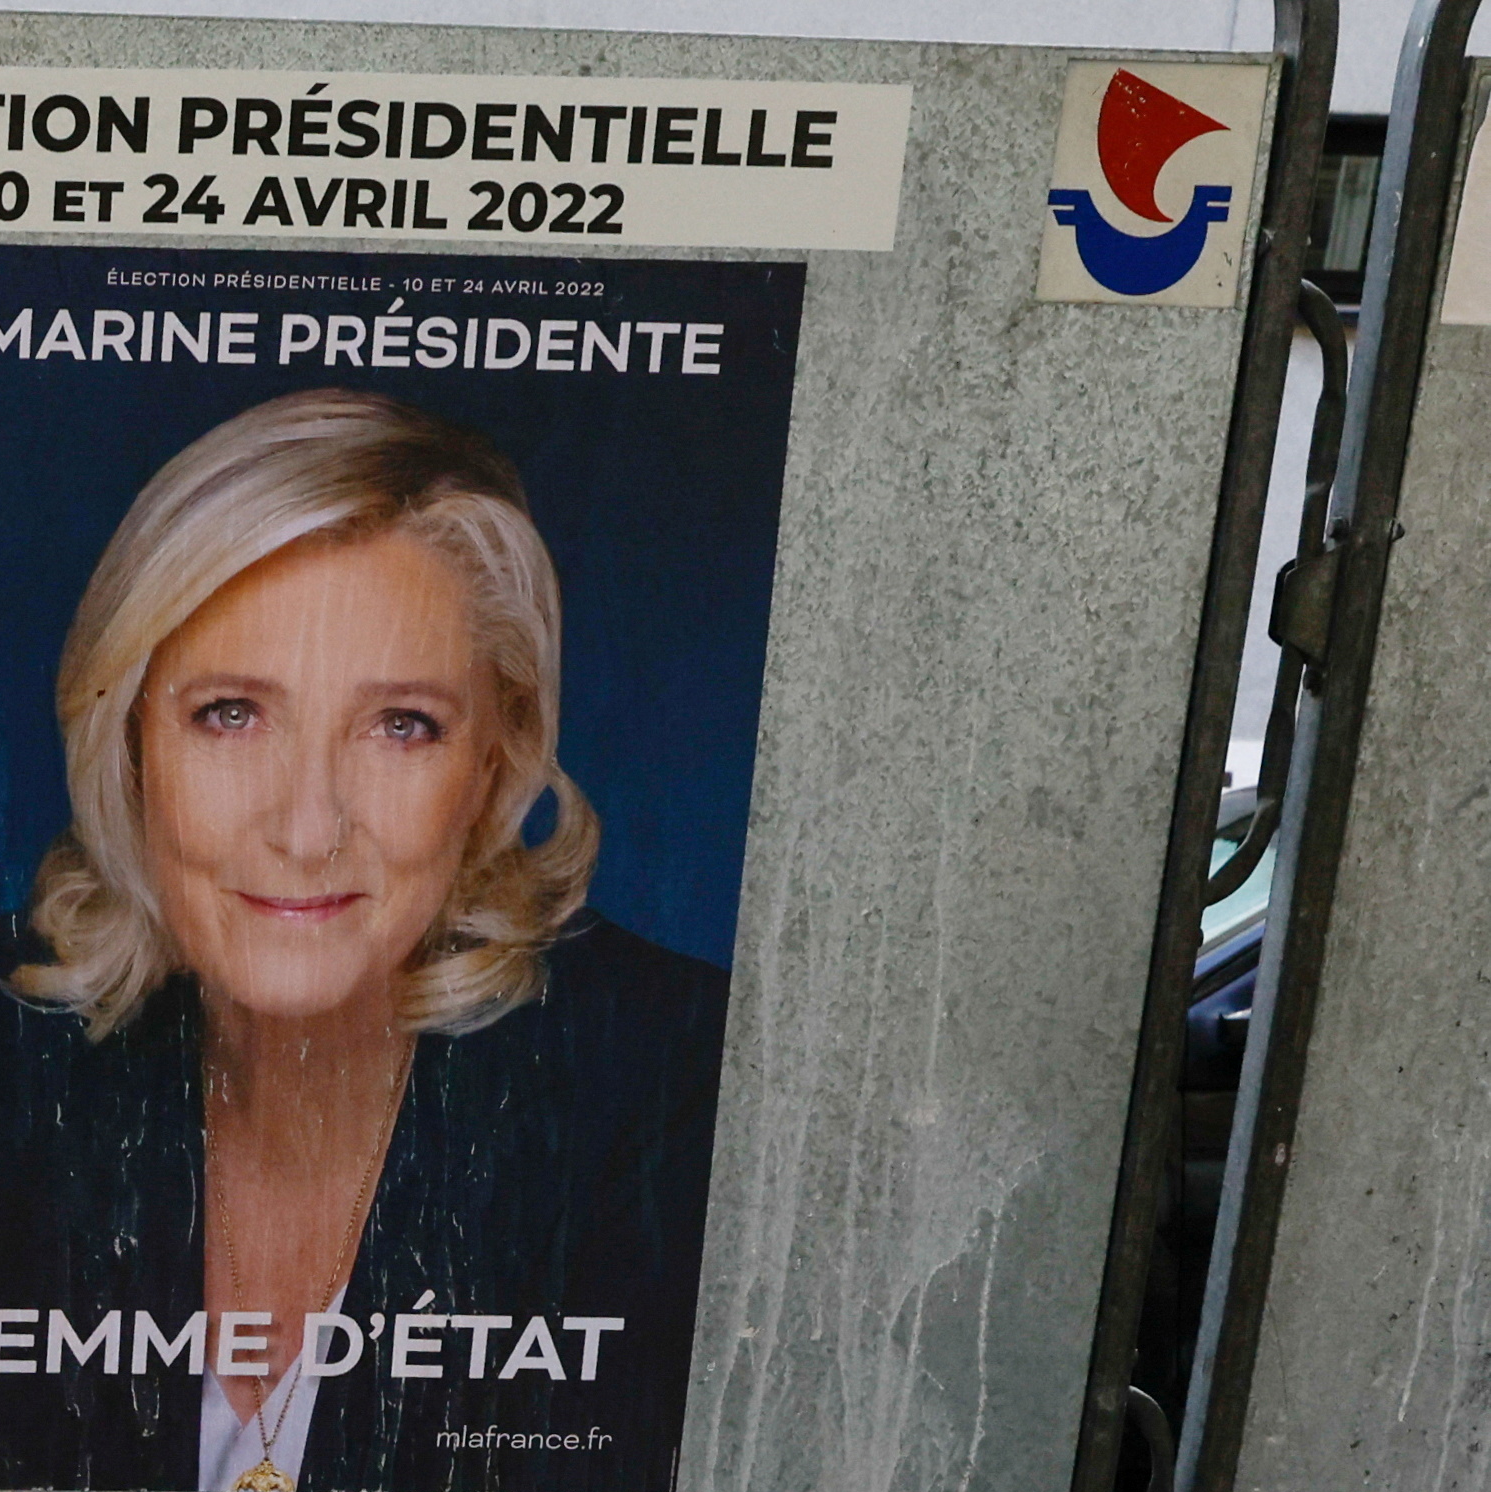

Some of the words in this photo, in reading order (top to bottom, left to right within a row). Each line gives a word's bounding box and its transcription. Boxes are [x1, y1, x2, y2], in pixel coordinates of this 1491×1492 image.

[178, 82, 838, 169] PRÉSIDENTIELLE
[52, 180, 125, 223] ET
[142, 173, 226, 225] 24
[242, 176, 448, 230] AVRIL
[467, 180, 625, 235] 2022
[107, 267, 206, 288] ÉLECTION
[213, 270, 381, 291] PRÉSIDENTIELLE
[402, 277, 424, 292] 10
[431, 278, 456, 293] ET
[463, 279, 484, 294] 24
[491, 280, 548, 295] AVRIL
[555, 281, 605, 297] 2022
[278, 296, 725, 375] PRÉSIDENTE
[435, 1424, 613, 1452] mlafrance.fr
